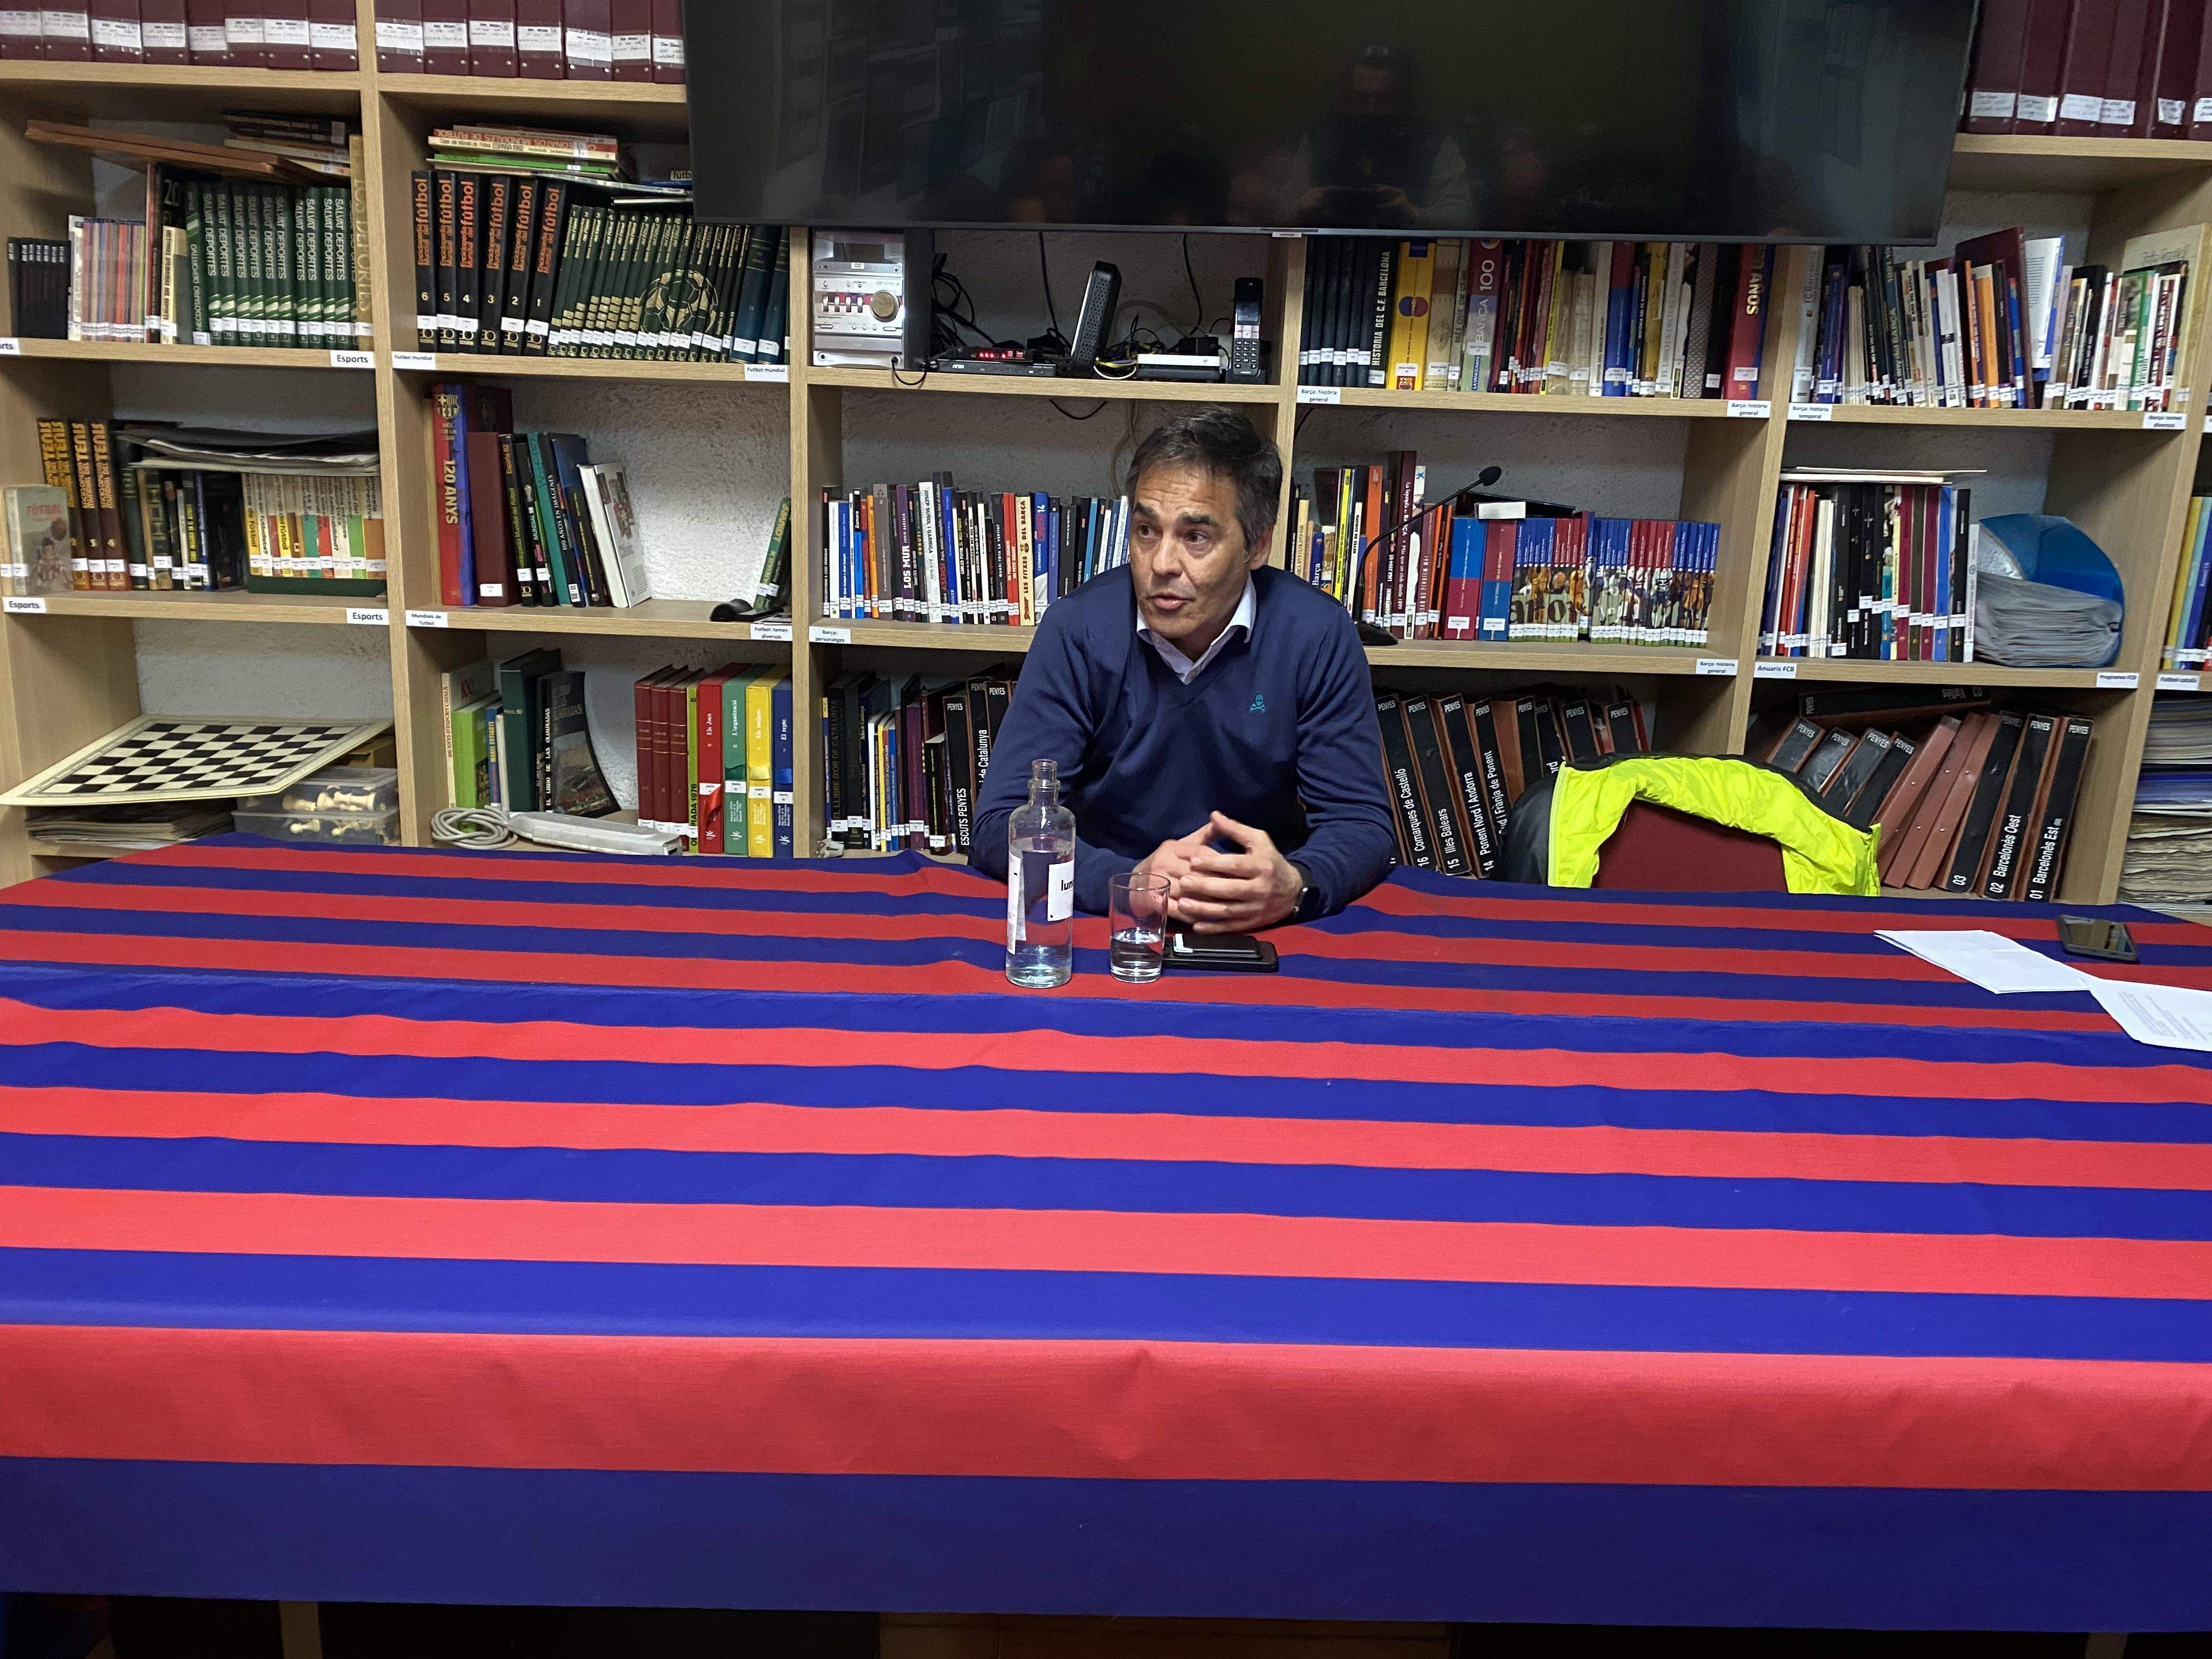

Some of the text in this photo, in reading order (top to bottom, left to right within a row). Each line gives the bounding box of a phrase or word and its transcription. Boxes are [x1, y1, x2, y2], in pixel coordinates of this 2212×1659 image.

[204, 193, 216, 276] SALVAT DEPORTES
[217, 194, 229, 276] SALVAT DEPORTES
[295, 199, 305, 281] SALVAT DEPORTES
[190, 244, 199, 284] DEPORTIVO
[307, 233, 317, 281] DEPORTES
[324, 233, 334, 280] DEPORTES
[444, 293, 450, 301] 5
[462, 295, 470, 303] 4
[487, 295, 494, 303] 3
[511, 296, 518, 305] 2
[1475, 259, 1494, 342] BARÇA 100
[1746, 273, 1763, 314] AÑOS
[537, 298, 540, 307] 1
[1372, 251, 1390, 366] HISTORIA DEL C.F. BARCELONA
[337, 354, 368, 363] Esports
[503, 444, 509, 453] 82
[443, 459, 459, 524] 120 ANYS
[550, 475, 561, 508] IMÁGENES
[1037, 504, 1045, 512] 14
[512, 516, 521, 538] Mundial
[530, 515, 538, 540] MUNDIAL
[555, 520, 565, 539] AÑOS
[560, 539, 568, 550] 100
[901, 545, 912, 589] LOS MUR
[1312, 563, 1321, 586] Barça
[939, 563, 947, 590] ASENSI
[9, 601, 40, 610] Esports
[353, 613, 383, 621] Esports
[989, 687, 1006, 696] PENYES
[947, 703, 963, 711] PENYES
[1378, 699, 1396, 712] PENYES
[1408, 701, 1426, 713] PENYES
[1444, 700, 1460, 713] PENYES
[1475, 704, 1490, 716] PENYES
[1518, 701, 1532, 713] PENYES
[1566, 706, 1585, 718] PENYES
[1610, 707, 1629, 719] PENYES
[1796, 723, 1815, 738] PENYES
[2030, 720, 2051, 731] PENYES
[2068, 724, 2089, 735] PENYES
[1831, 732, 1850, 747] PENYES
[1866, 732, 1889, 749] PENYES
[1894, 737, 1915, 754] PENYES
[830, 700, 840, 820] EL LLIBRE DE CATALUNYA
[978, 730, 989, 779] de Catalunya
[545, 764, 550, 772] DE
[1483, 751, 1504, 819] Franja de Ponent
[956, 788, 970, 846] ESCUTS PENYES
[1394, 768, 1429, 867] 16 Comarques de Castelló
[1464, 771, 1494, 872] 14 Ponent Nord Andorra
[1437, 808, 1459, 868] 15 Illes Balears
[1990, 815, 2022, 894] 02 Barcelonès Oest
[2029, 825, 2059, 900] 01 Barcelonès Est
[1953, 874, 1966, 886] 03
